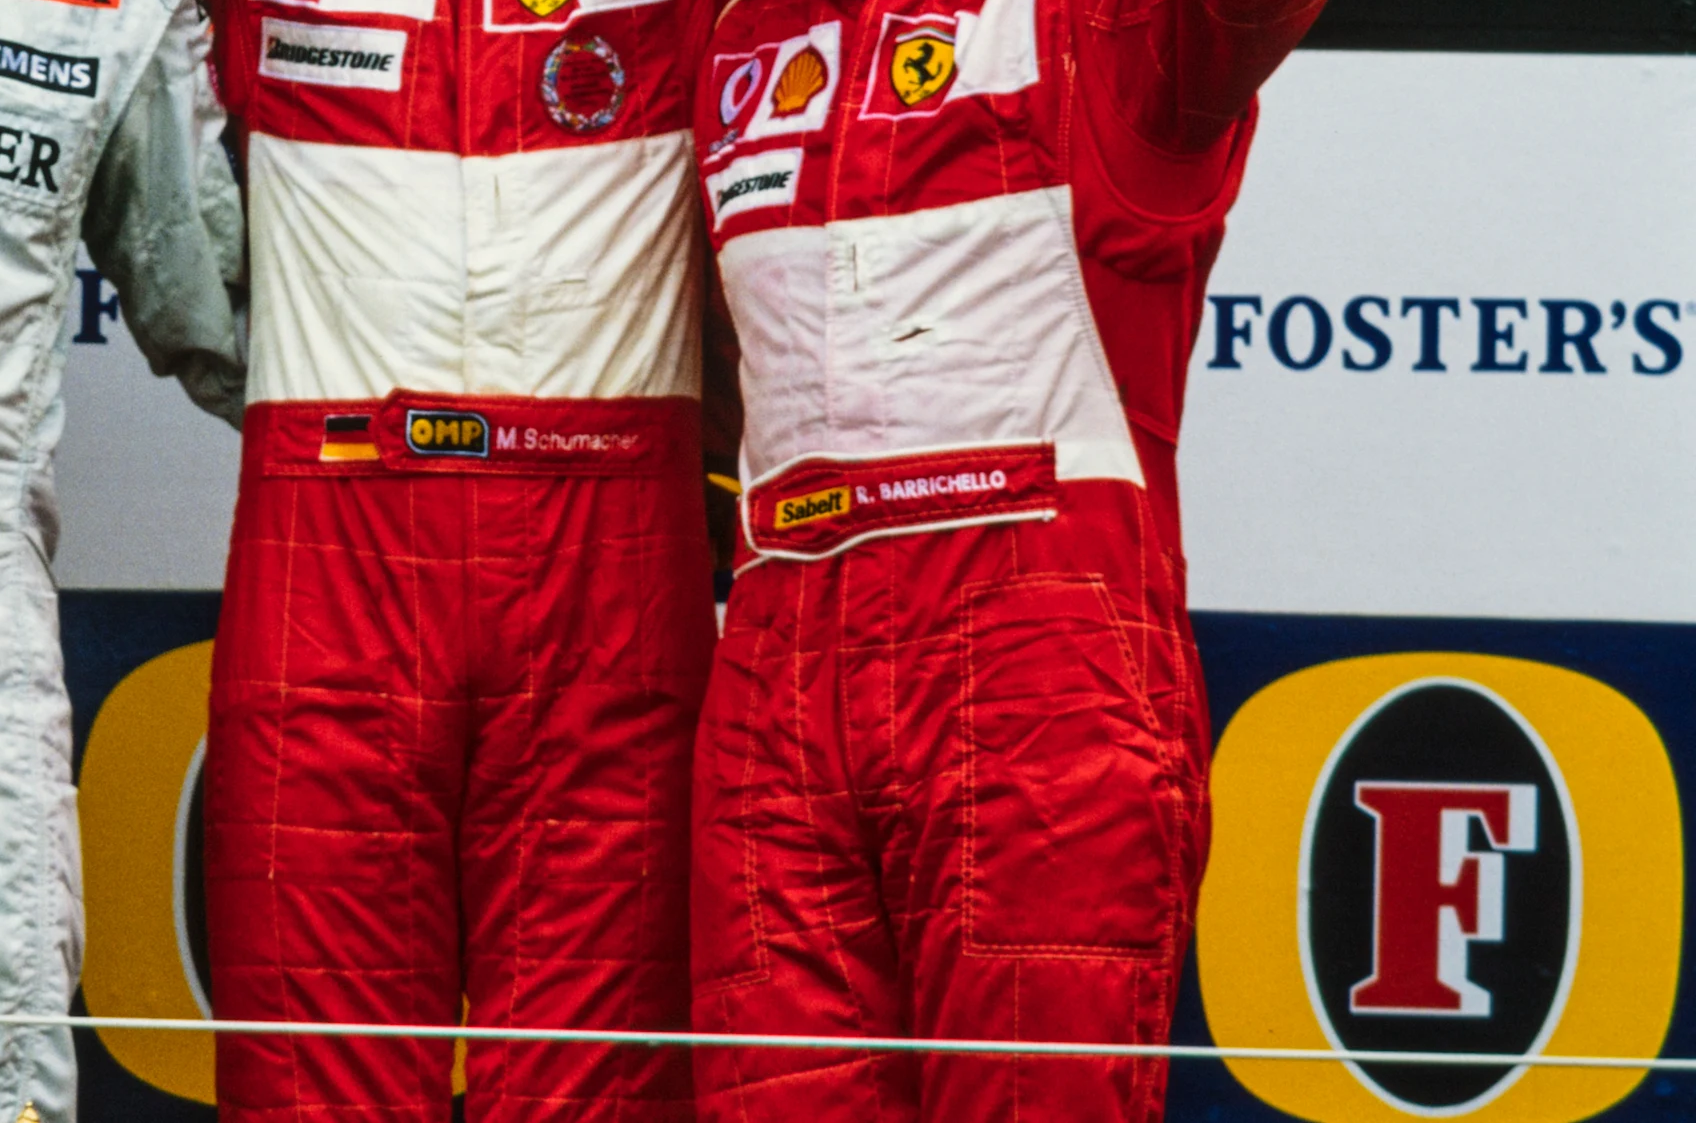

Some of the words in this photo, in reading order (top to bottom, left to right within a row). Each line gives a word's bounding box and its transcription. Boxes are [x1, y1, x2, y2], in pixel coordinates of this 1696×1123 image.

[267, 36, 395, 73] BRIDGESTONE
[1207, 295, 1683, 376] FOSTER'S
[411, 418, 483, 446] OMP
[496, 426, 518, 450] M.
[523, 427, 639, 451] Schumacher
[780, 490, 843, 524] Sabelt
[855, 485, 875, 505] R.
[879, 469, 1007, 502] BARRICHELLO
